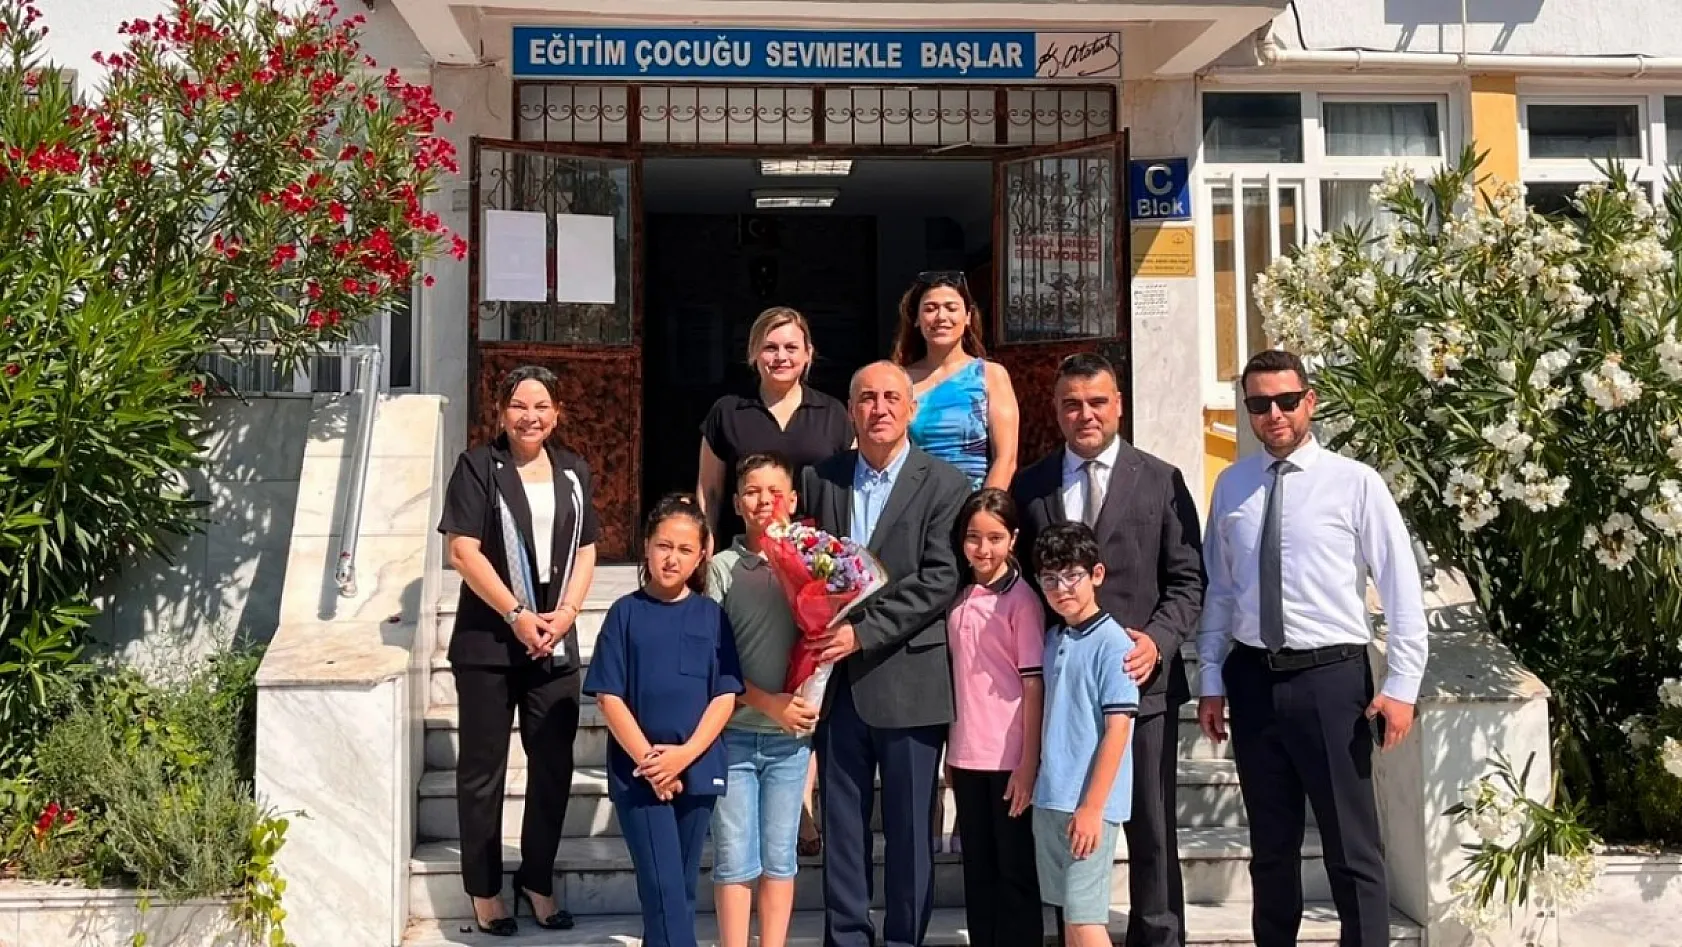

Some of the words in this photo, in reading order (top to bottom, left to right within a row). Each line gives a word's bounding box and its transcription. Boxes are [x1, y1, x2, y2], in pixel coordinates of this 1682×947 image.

[529, 33, 626, 65] EĞİTİM
[635, 35, 750, 73] ÇOCUĞU
[765, 41, 903, 68] SEVMEKLE
[920, 42, 1024, 74] BAŞLAR
[1144, 163, 1173, 196] C
[1137, 197, 1185, 217] Blok
